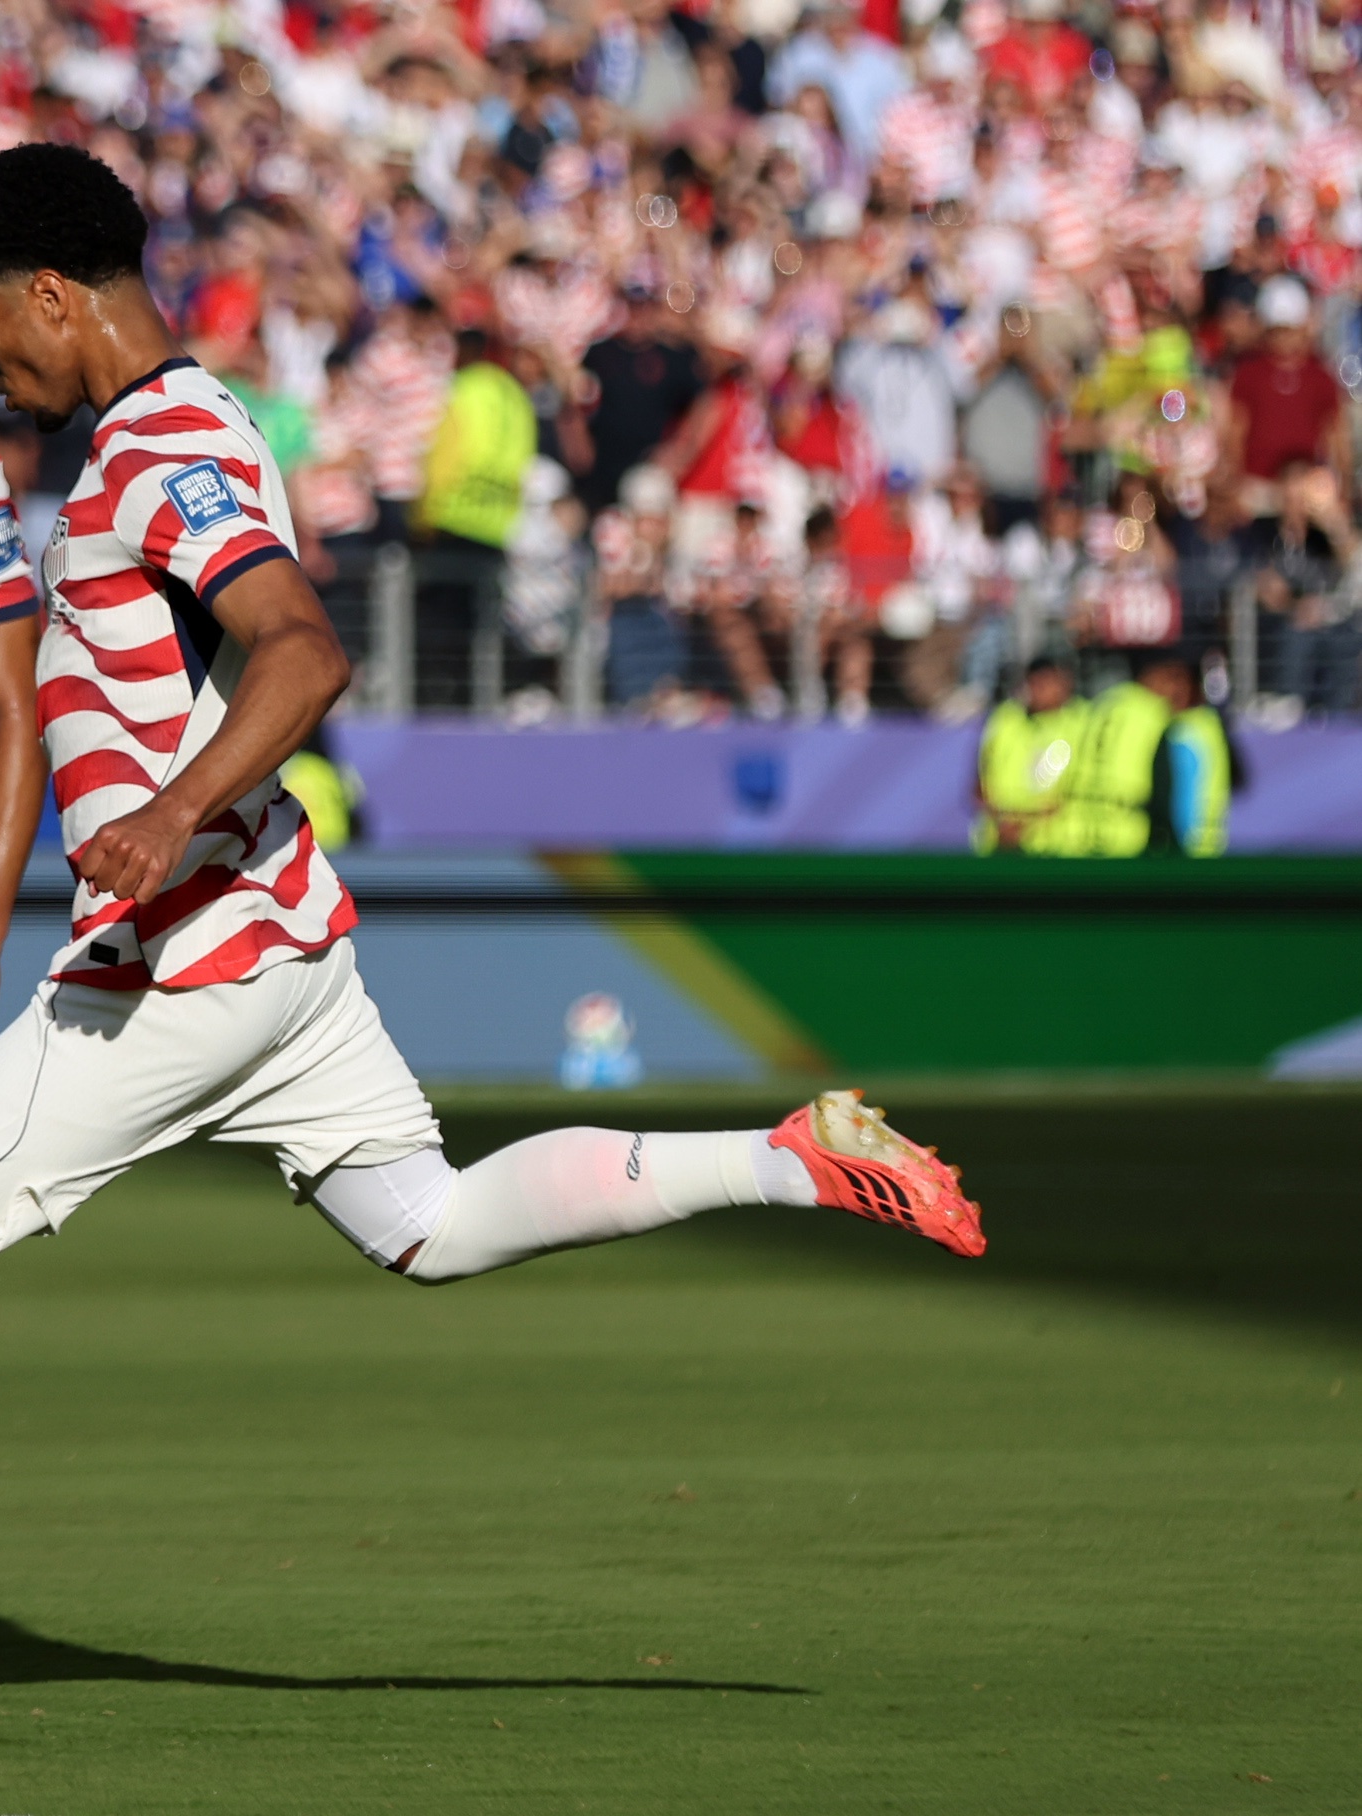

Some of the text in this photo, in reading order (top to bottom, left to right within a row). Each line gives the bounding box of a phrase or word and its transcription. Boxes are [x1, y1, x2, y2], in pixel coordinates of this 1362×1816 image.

[174, 469, 215, 493] FOOTBALL
[180, 477, 221, 505] UNITES
[51, 518, 67, 546] SA
